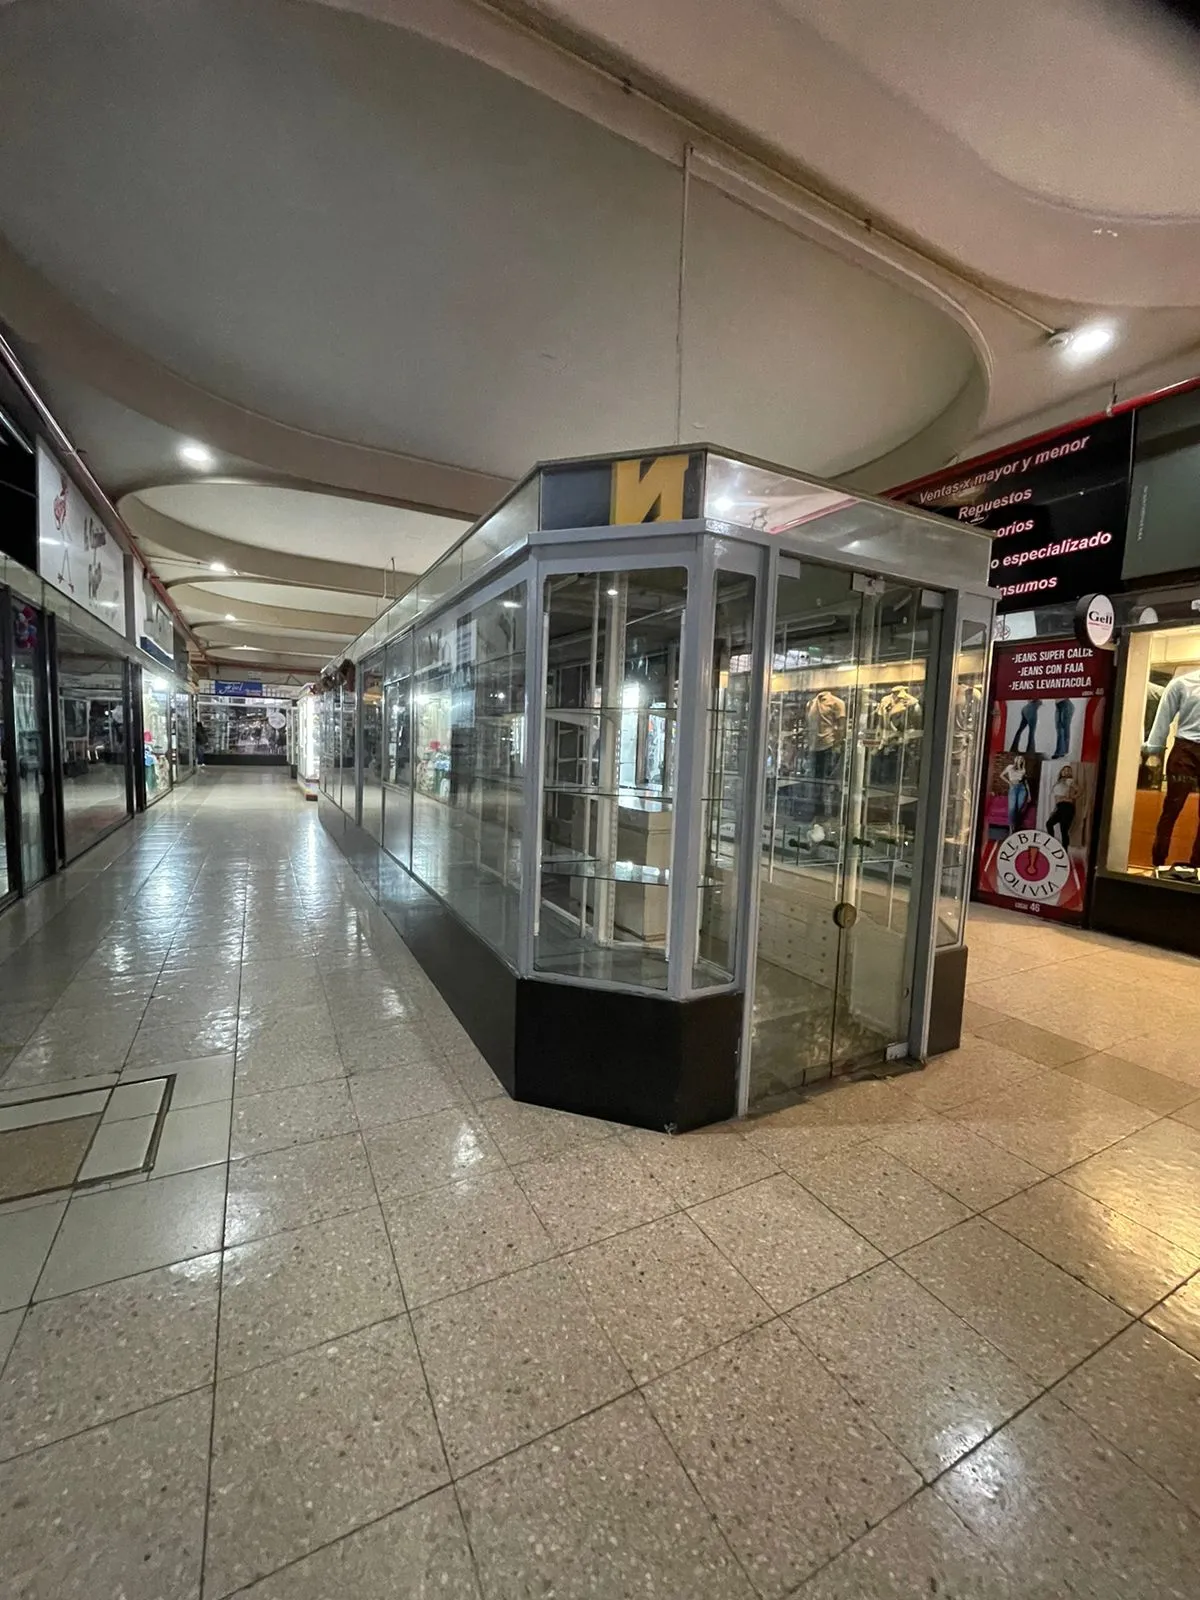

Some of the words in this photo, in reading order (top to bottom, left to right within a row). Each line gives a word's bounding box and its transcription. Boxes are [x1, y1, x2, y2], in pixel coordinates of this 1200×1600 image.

[920, 482, 959, 504] Ventas
[974, 461, 1019, 485] mayor
[1021, 454, 1032, 471] y
[1034, 435, 1091, 465] menor
[957, 487, 1033, 519] Repuestos
[1002, 531, 1112, 566] especializado
[1039, 649, 1065, 661] SUPER
[1045, 664, 1062, 675] CON
[1064, 662, 1084, 673] FAJA
[1036, 676, 1092, 689] LEVANTACOLA
[1003, 871, 1060, 897] OLIVIA
